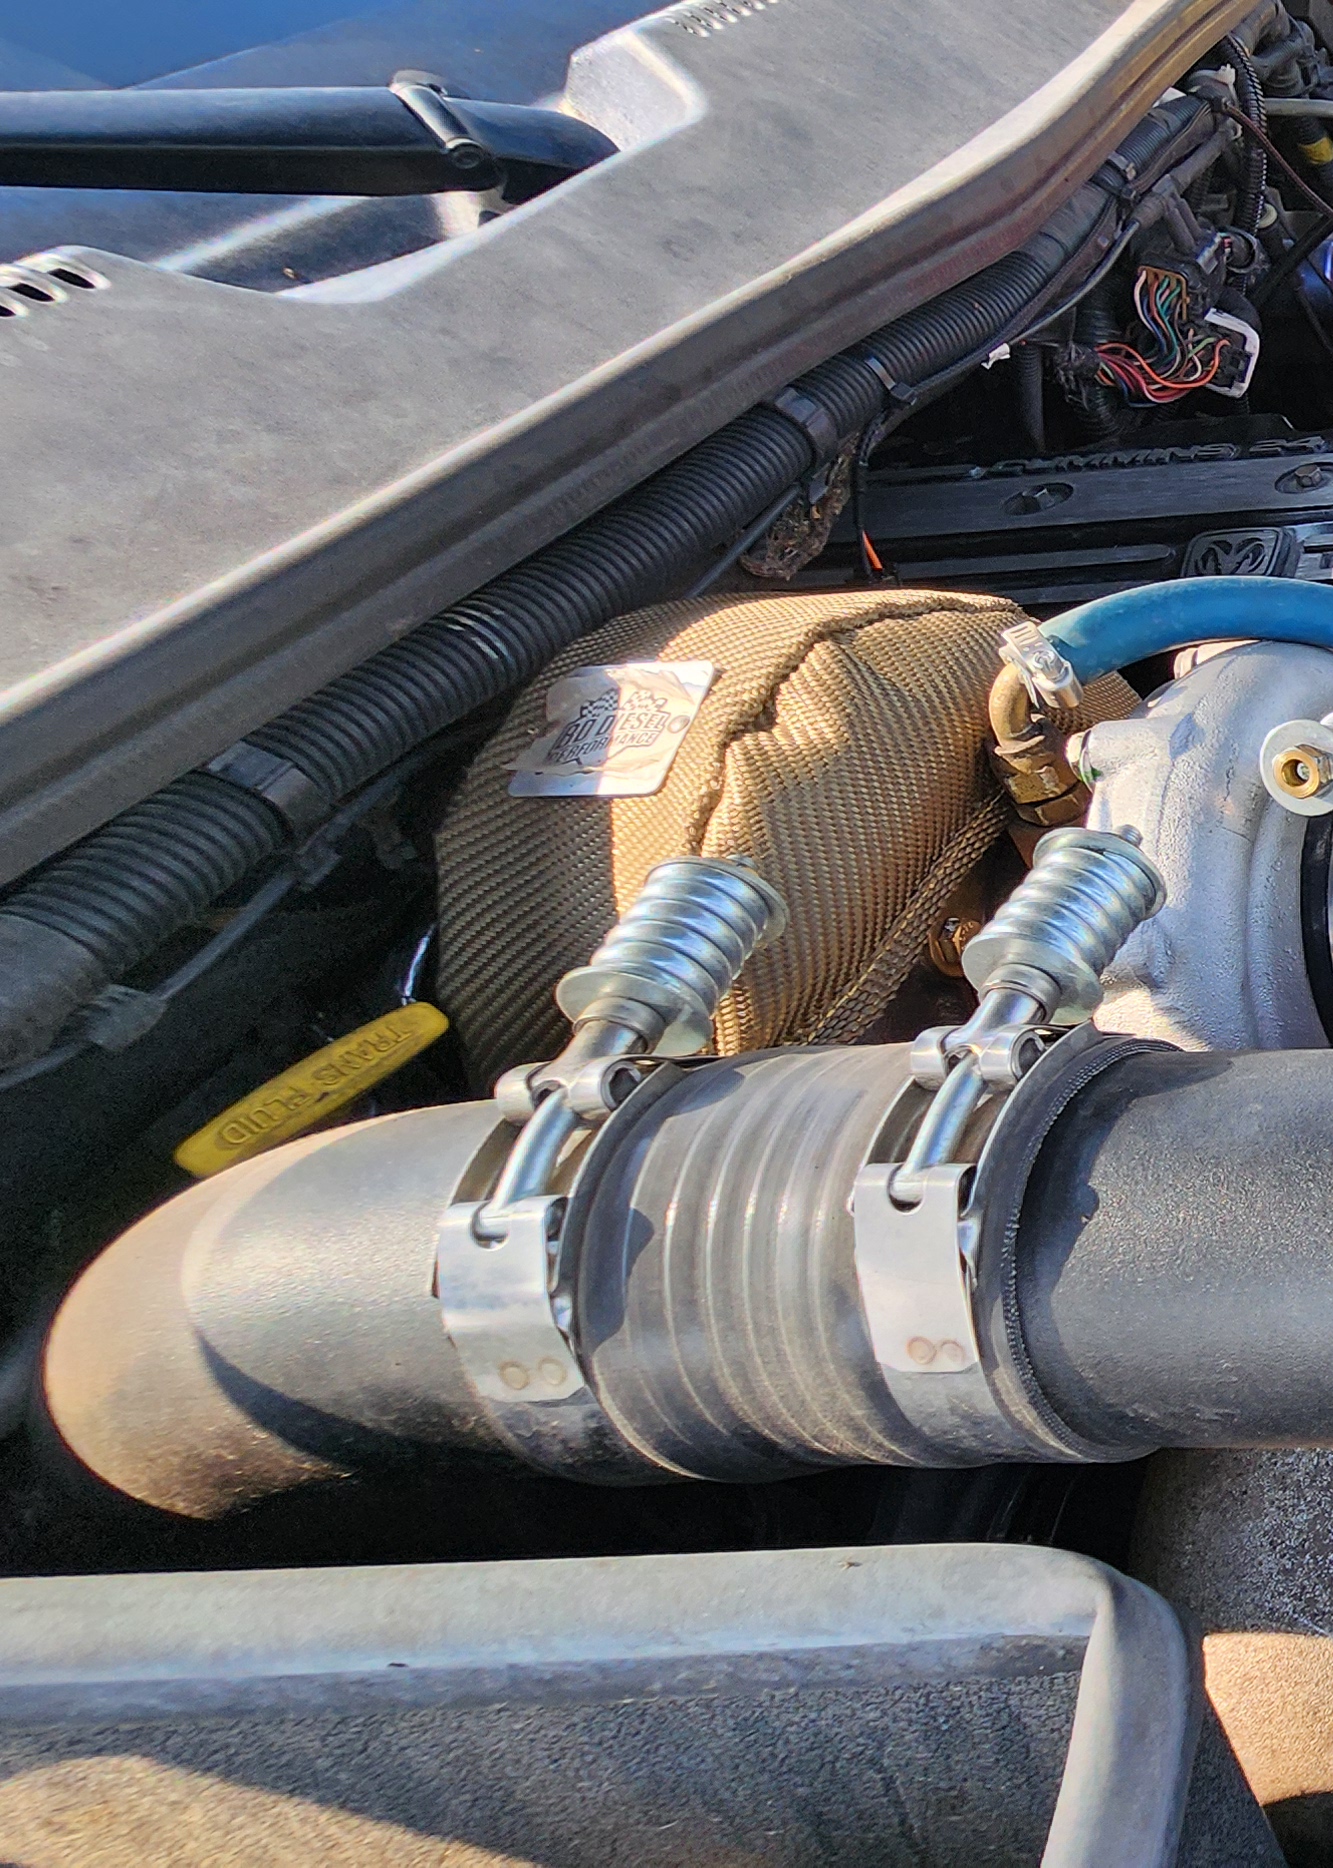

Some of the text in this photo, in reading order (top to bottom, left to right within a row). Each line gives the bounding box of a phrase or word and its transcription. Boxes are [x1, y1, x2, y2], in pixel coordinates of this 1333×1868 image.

[987, 442, 1241, 477] CUMMINS
[1248, 434, 1326, 457] 24
[595, 712, 669, 737] DIESEL
[219, 1020, 413, 1145] TRANS FLUID
